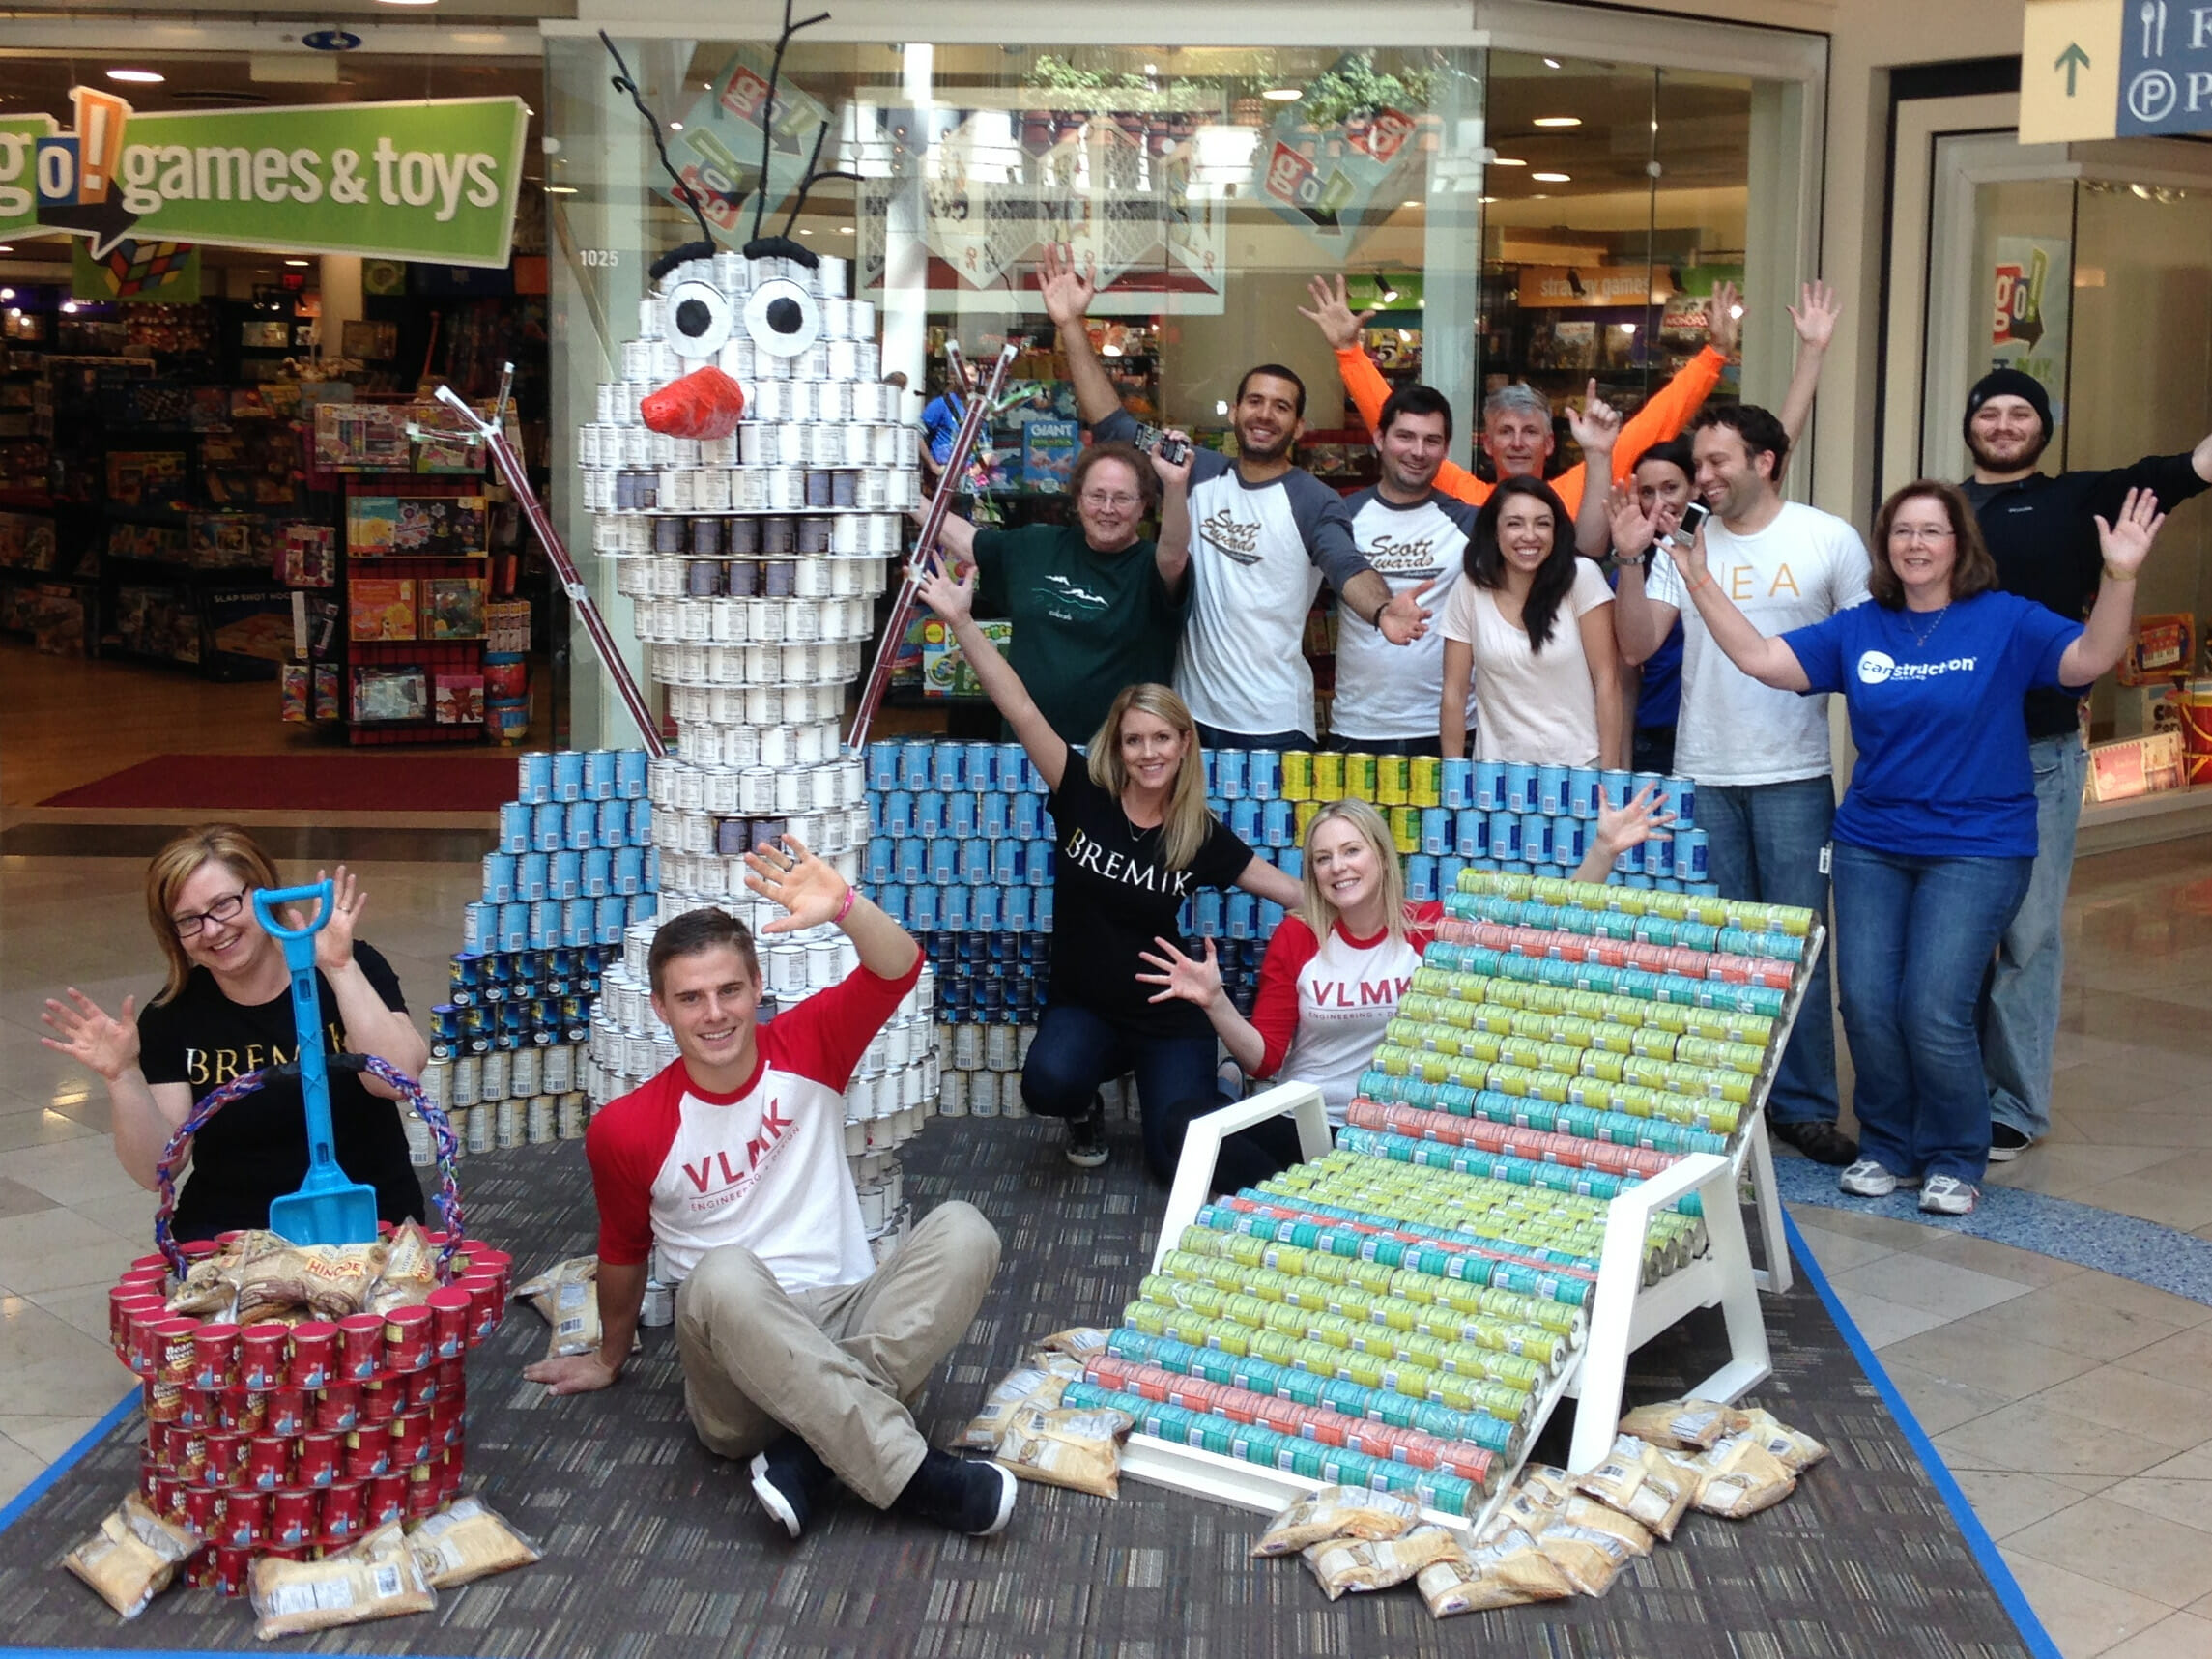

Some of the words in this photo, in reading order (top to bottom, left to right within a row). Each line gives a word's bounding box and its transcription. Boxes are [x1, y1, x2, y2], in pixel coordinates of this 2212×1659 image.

[122, 144, 323, 215] games
[330, 149, 368, 204] &
[372, 138, 499, 221] toys
[580, 250, 619, 267] 1025
[1993, 260, 2042, 333] go!
[1030, 424, 1073, 436] GIANT
[1364, 535, 1434, 557] Scott
[1065, 826, 1194, 897] BREMIK
[1312, 976, 1412, 1007] VLMK
[1308, 1011, 1372, 1020] ENGINEERING
[682, 1098, 794, 1193] VLMK
